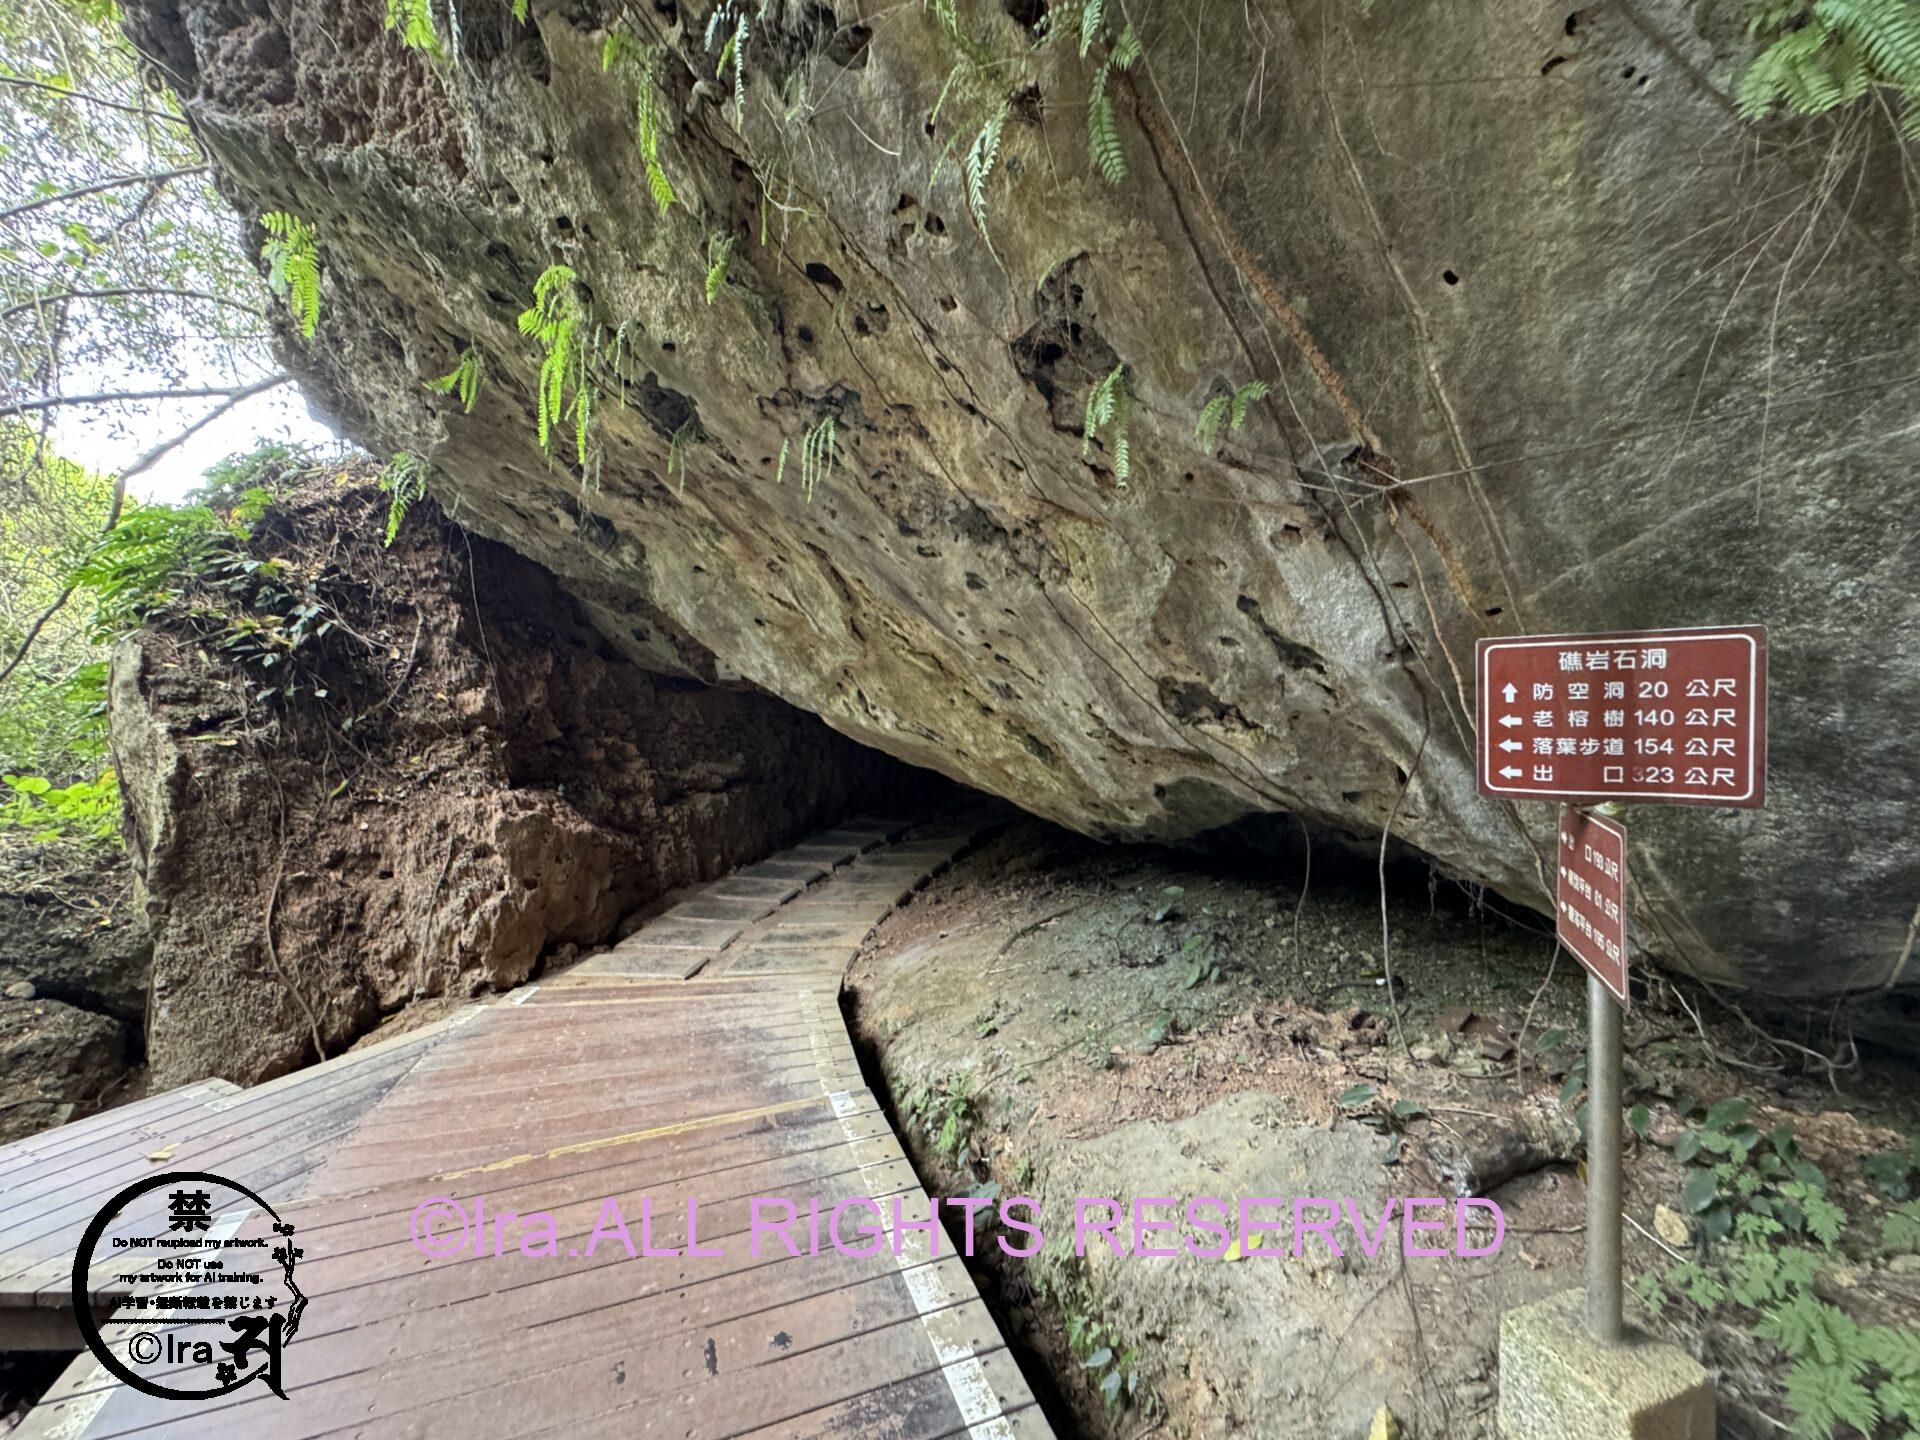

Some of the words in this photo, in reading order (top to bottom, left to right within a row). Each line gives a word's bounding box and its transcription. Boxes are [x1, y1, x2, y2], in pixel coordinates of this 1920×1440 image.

[1559, 648, 1667, 671] 礁岩石洞
[1639, 681, 1668, 698] 20
[1686, 679, 1736, 697] 公尺
[1635, 709, 1674, 725] 140
[1685, 709, 1736, 727] 公尺
[1533, 737, 1624, 755] 落葉步道
[1635, 738, 1673, 754] 154
[1685, 738, 1735, 756] 公尺
[1633, 767, 1674, 783] 323
[1685, 767, 1735, 786] 公尺
